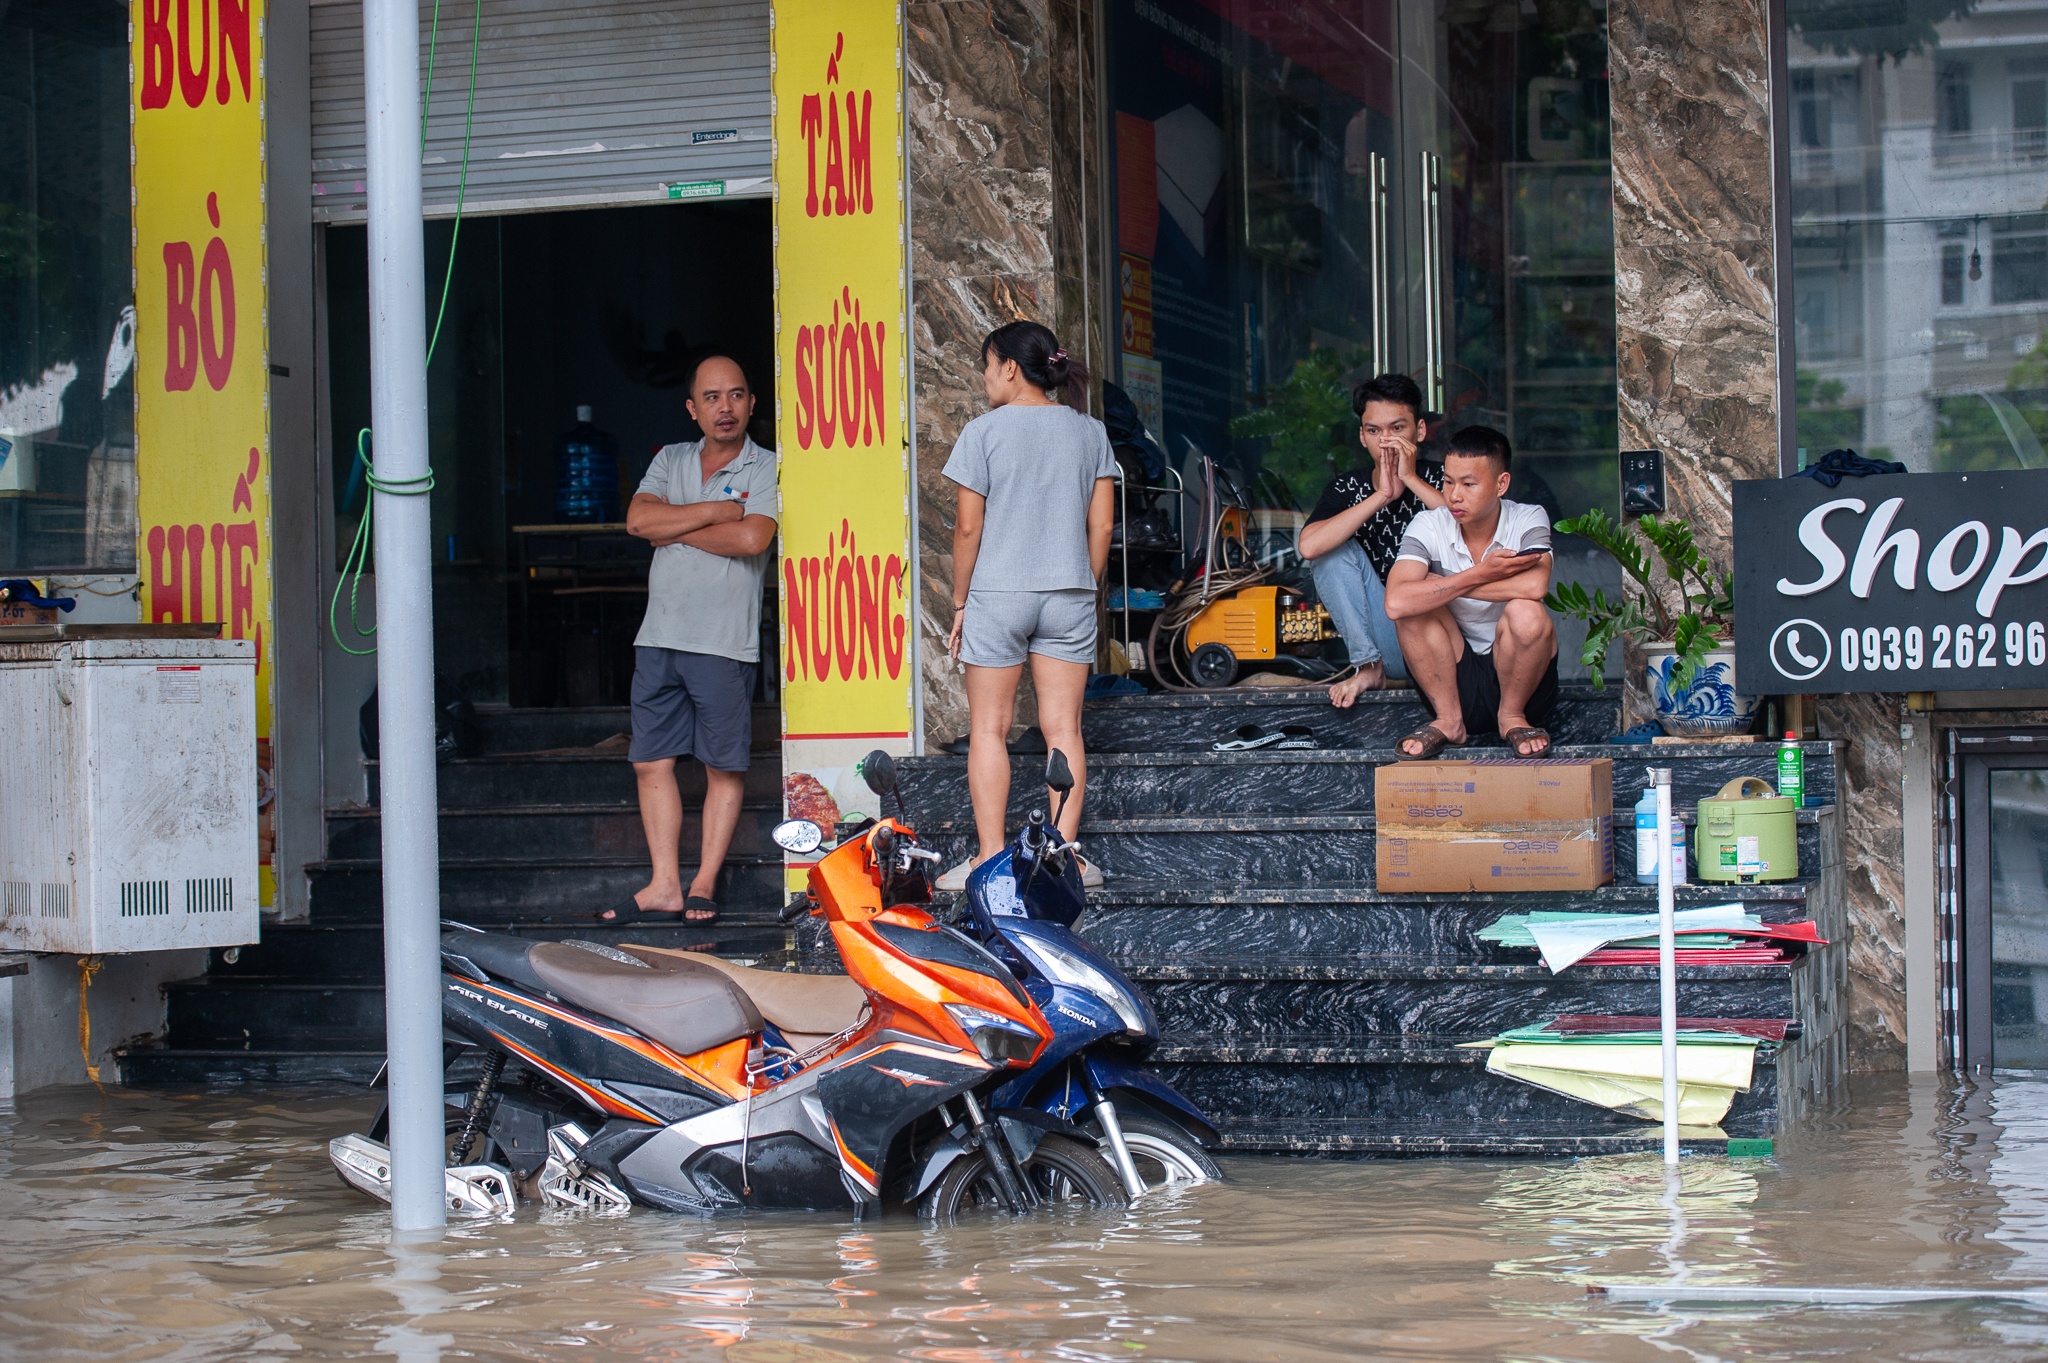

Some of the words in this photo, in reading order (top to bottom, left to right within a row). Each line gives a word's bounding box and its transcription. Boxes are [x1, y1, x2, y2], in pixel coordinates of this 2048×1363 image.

[801, 32, 873, 218] TẤM
[163, 191, 236, 392] BÒ
[796, 285, 885, 450] SƯỜN
[784, 518, 905, 682] NƯỚNG
[1776, 497, 2048, 618] Shop
[1840, 625, 1923, 672] 0939
[1932, 623, 1997, 669] 262
[2004, 621, 2046, 667] 96
[448, 984, 484, 1003] AIR
[486, 998, 549, 1030] BLADE
[1057, 1005, 1097, 1028] HONDA
